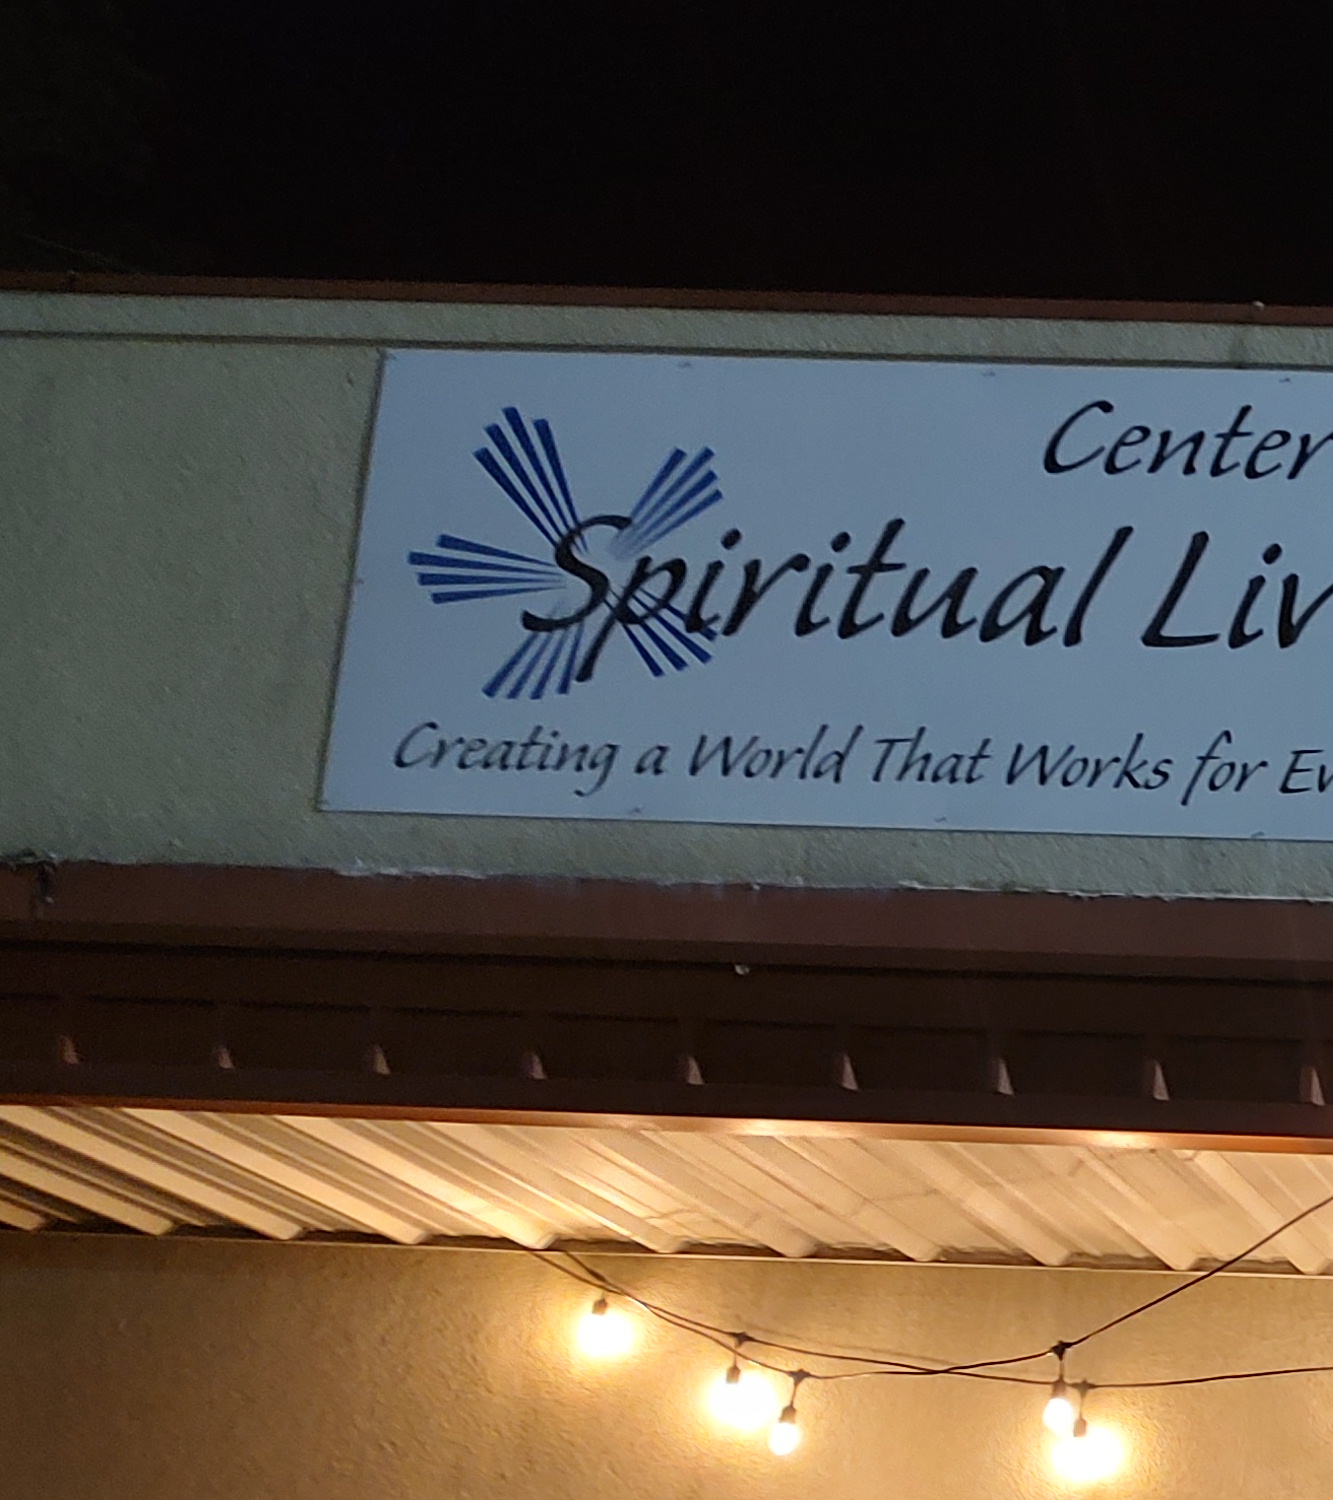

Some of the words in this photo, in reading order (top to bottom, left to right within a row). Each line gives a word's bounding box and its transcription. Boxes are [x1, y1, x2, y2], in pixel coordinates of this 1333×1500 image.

[522, 514, 1134, 682] Spiritual
[394, 720, 619, 796] Creating
[634, 744, 668, 777] a
[688, 724, 864, 784] World
[868, 725, 994, 785] That
[1004, 732, 1171, 794] Works
[1178, 730, 1267, 806] for
